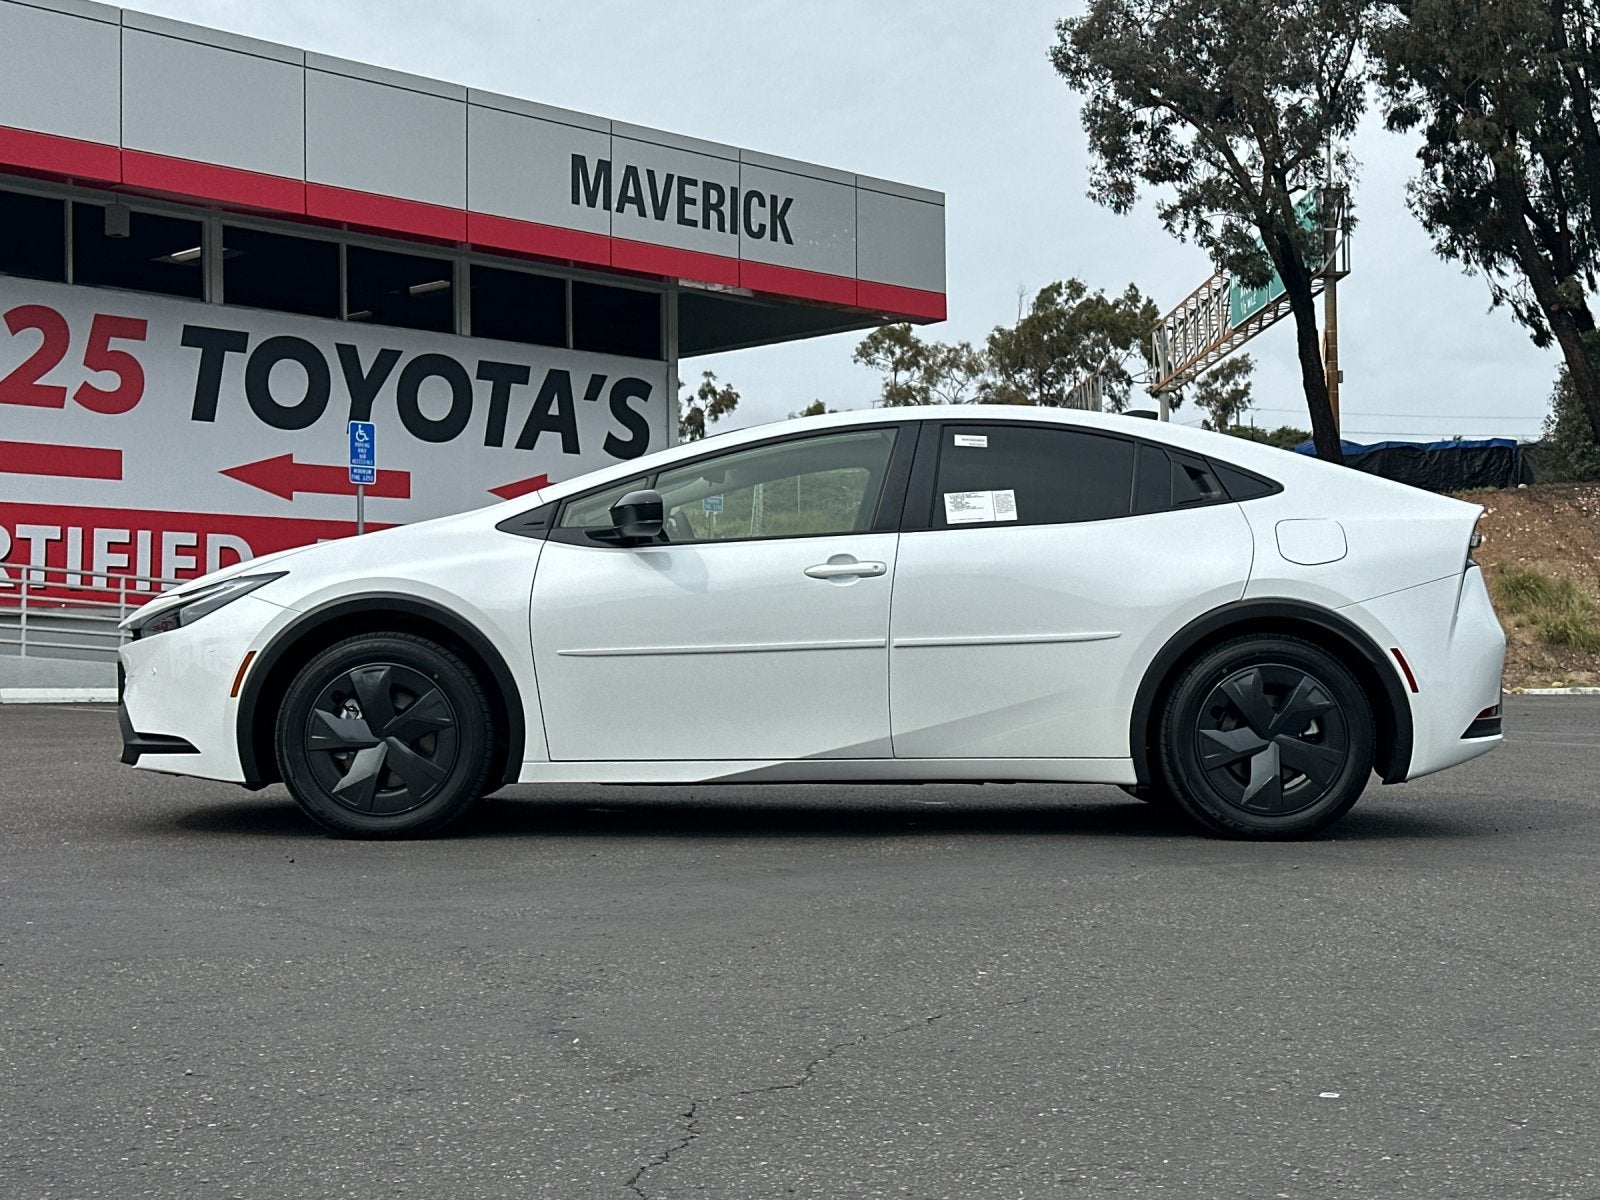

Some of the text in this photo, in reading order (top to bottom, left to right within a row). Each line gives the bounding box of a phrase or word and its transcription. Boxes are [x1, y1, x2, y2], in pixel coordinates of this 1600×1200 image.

[571, 153, 794, 246] MAVERICK
[0, 304, 653, 460] 25 TOYOTA'S
